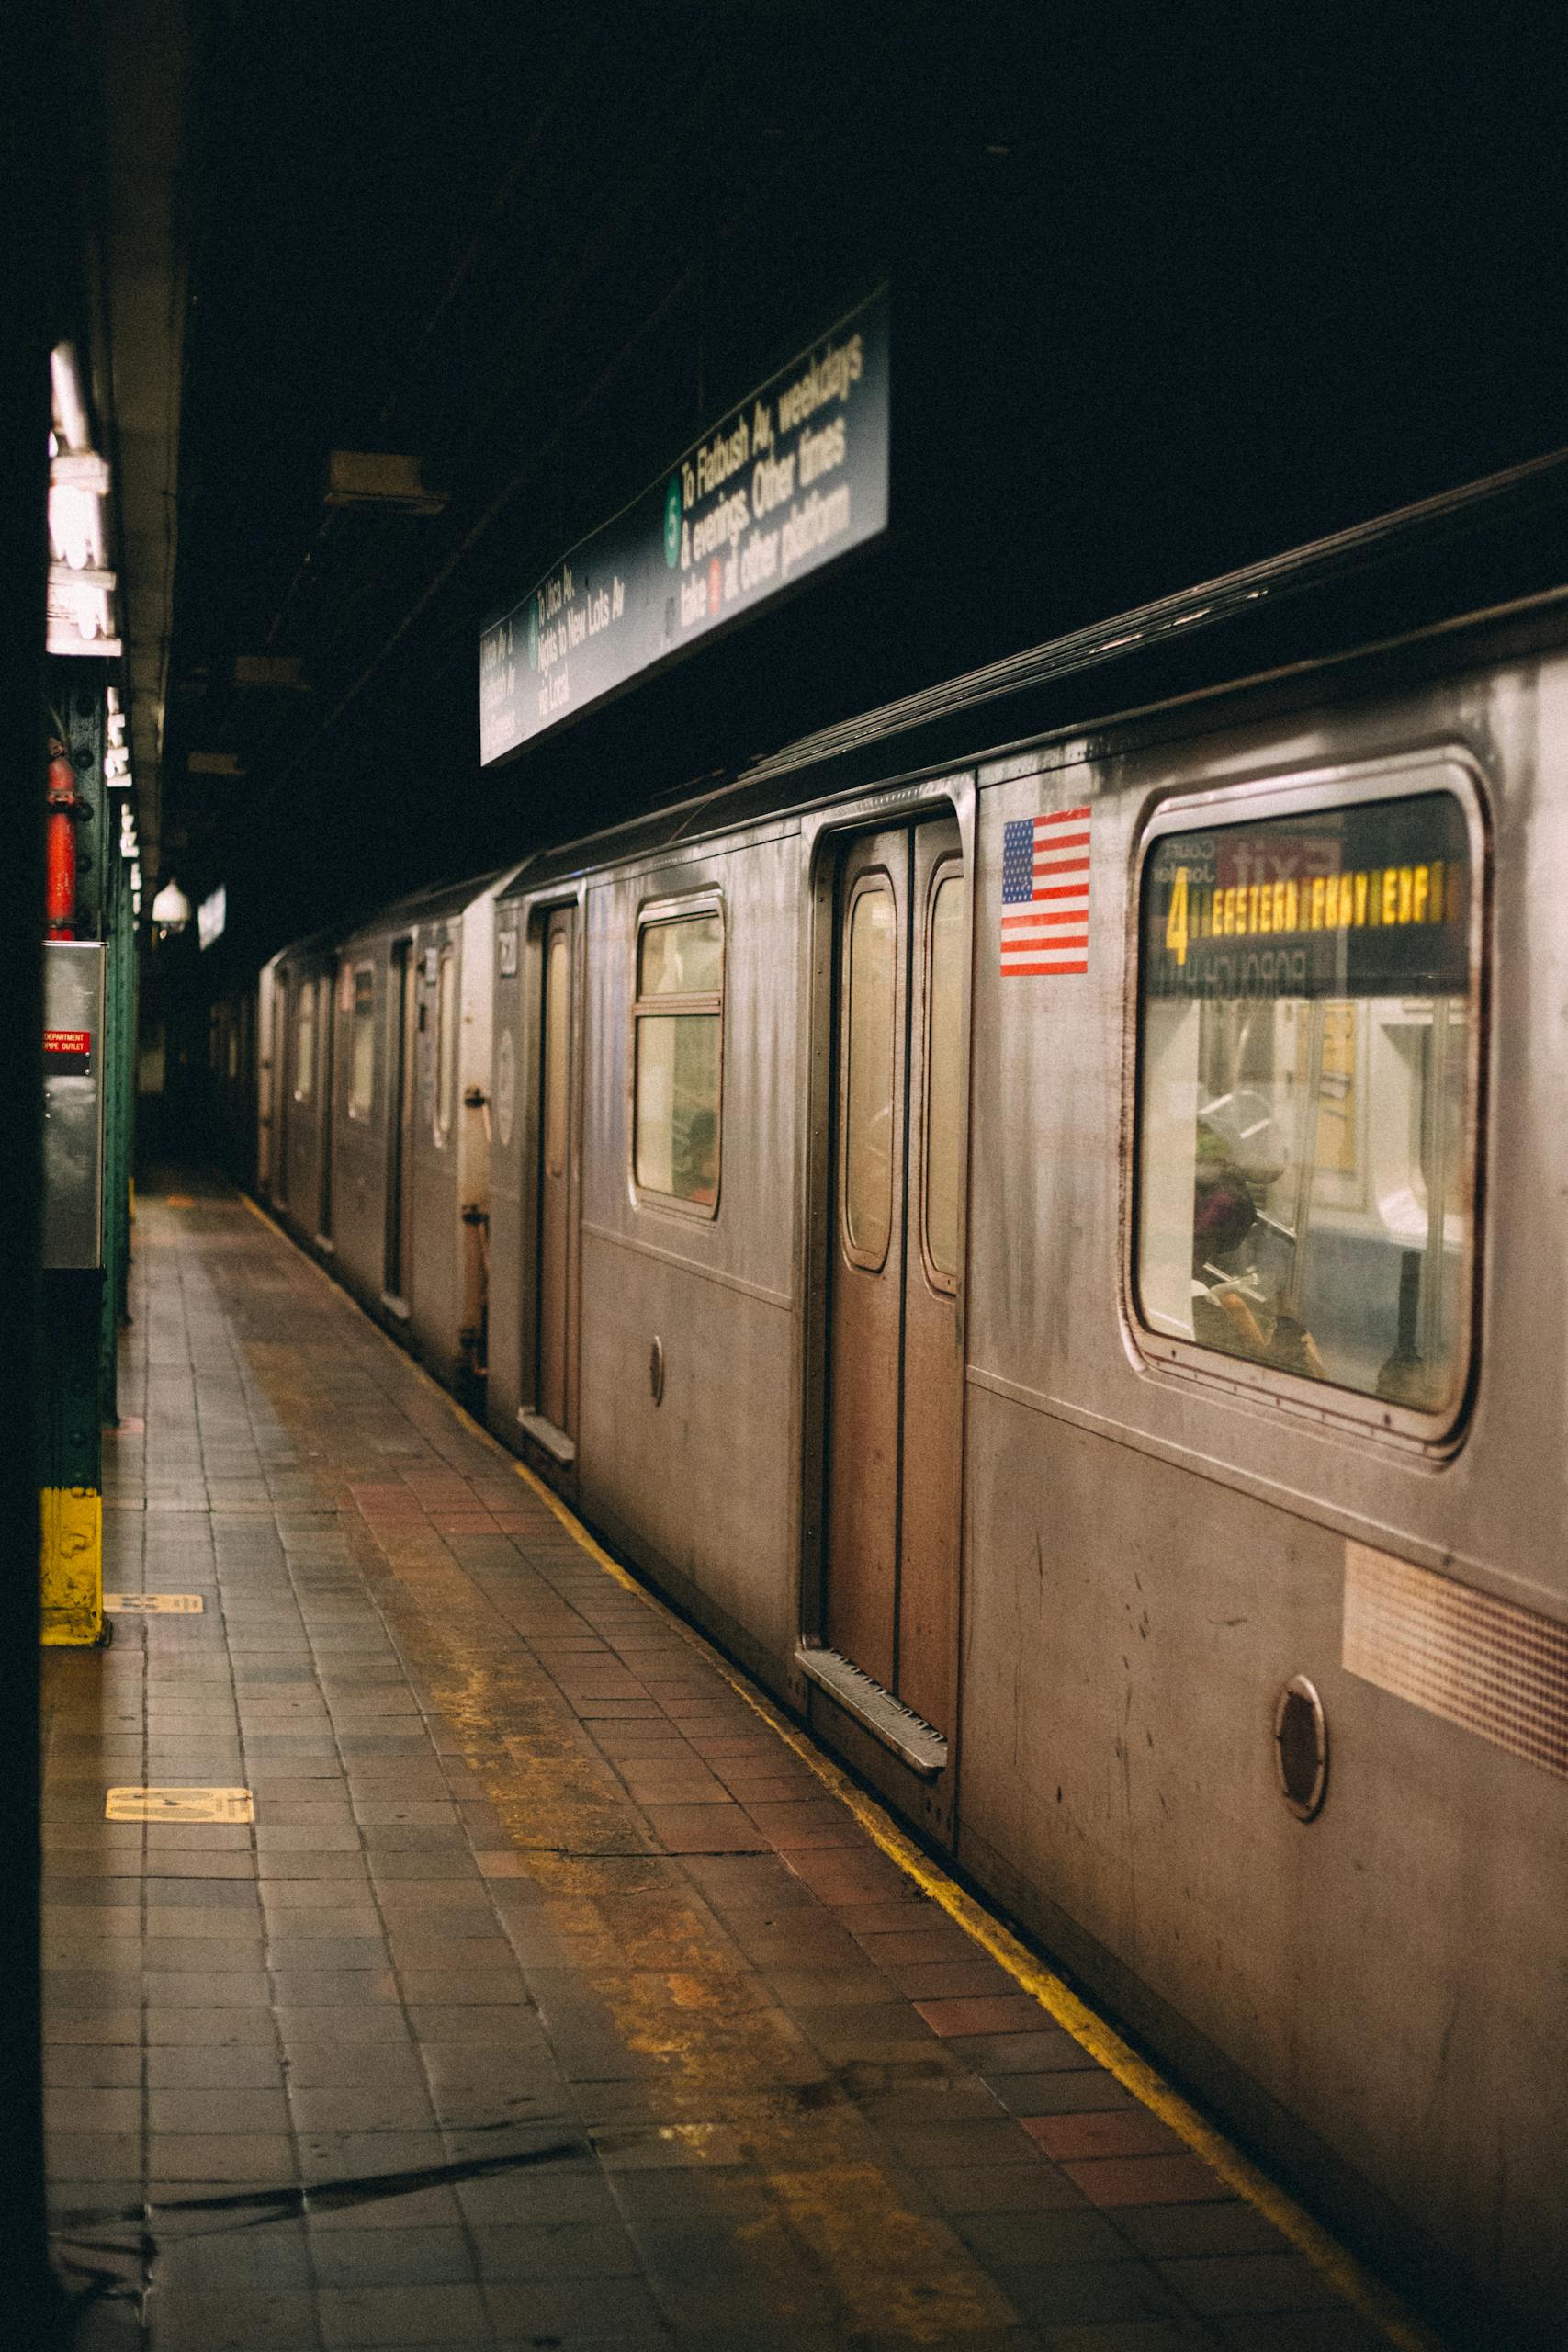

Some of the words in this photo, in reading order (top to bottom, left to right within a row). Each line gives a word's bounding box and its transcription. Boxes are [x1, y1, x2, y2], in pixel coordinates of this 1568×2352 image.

[682, 462, 694, 510] To
[698, 415, 749, 498] Flatbush
[778, 334, 863, 435] weekdays
[681, 520, 691, 571] &
[752, 454, 795, 520] Other
[799, 417, 845, 487] times
[558, 620, 567, 656] to
[568, 608, 586, 650] New
[588, 589, 610, 636] Lots
[613, 576, 625, 620] Av
[682, 573, 707, 627] take
[740, 529, 779, 592] other
[781, 484, 850, 581] platform
[1166, 867, 1188, 966] 4
[1213, 879, 1298, 937] EASTERN
[1312, 872, 1368, 931] PKWY
[1382, 865, 1428, 925] EXP
[44, 1033, 84, 1042] DEPARTMENT
